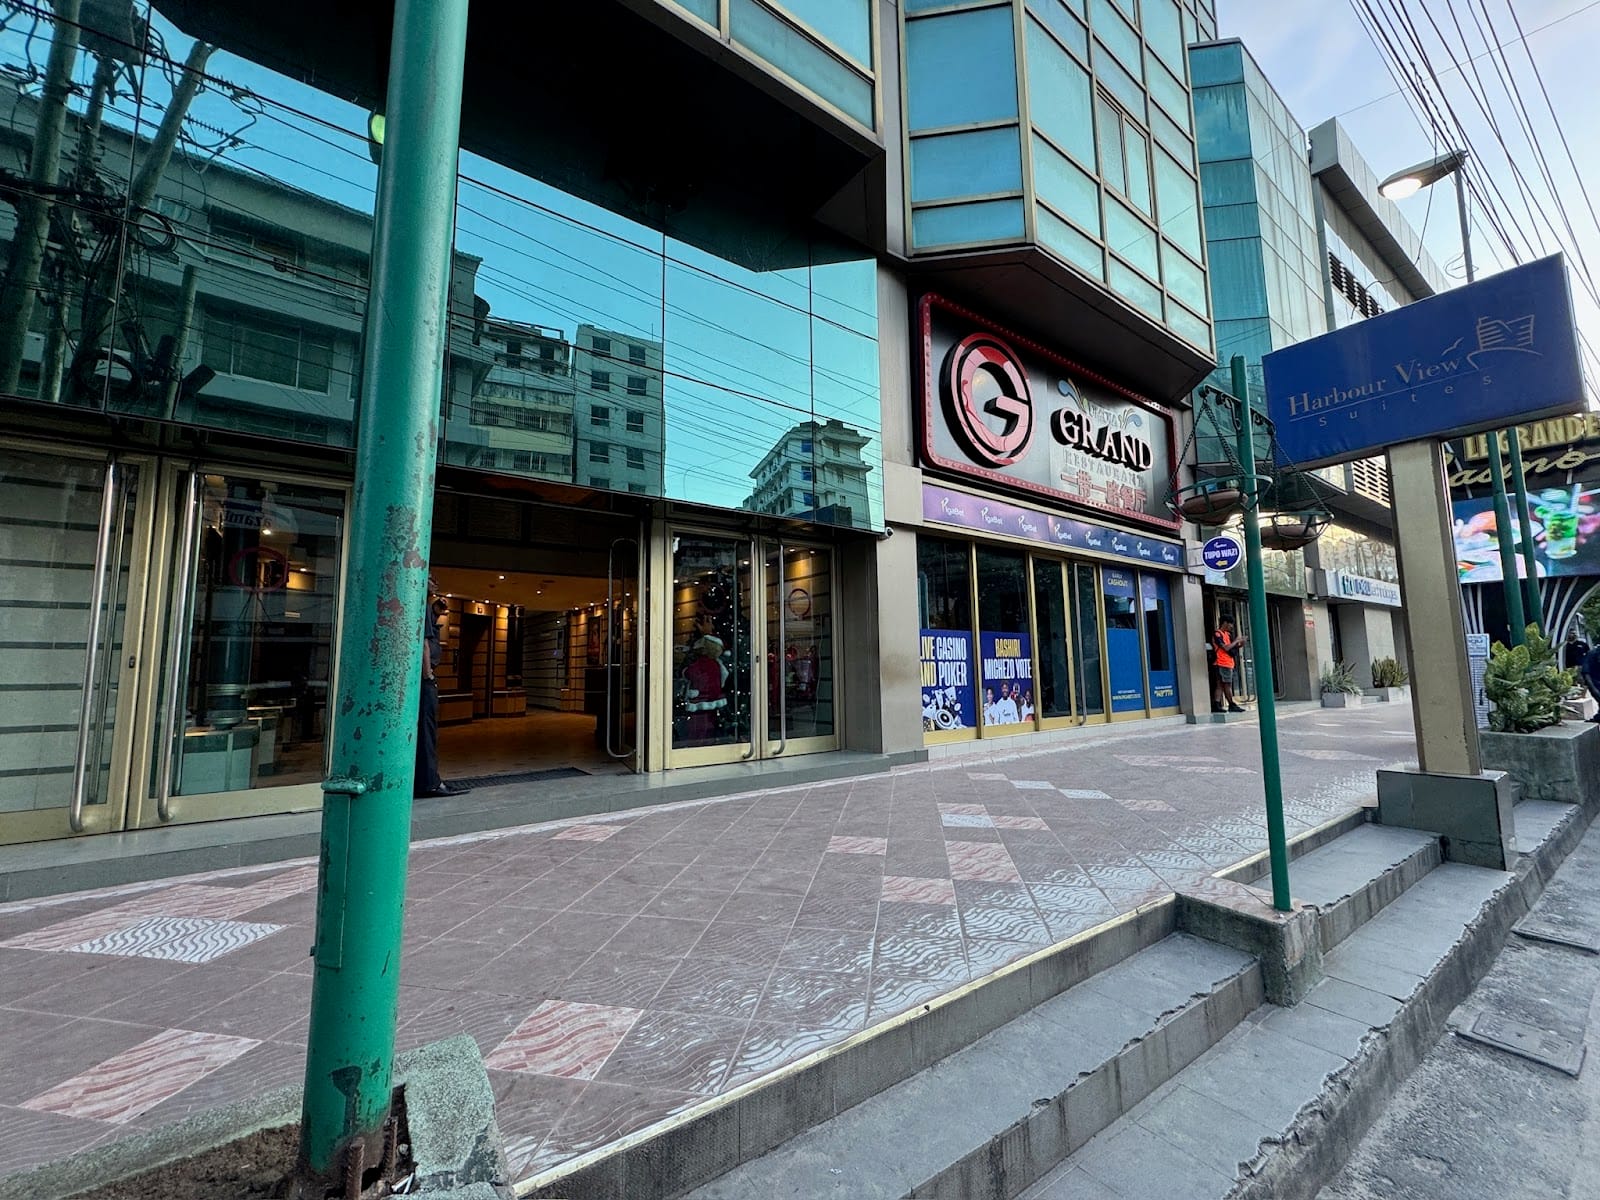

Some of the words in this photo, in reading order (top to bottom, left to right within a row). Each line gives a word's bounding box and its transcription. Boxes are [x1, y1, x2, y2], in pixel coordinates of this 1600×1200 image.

[1288, 379, 1387, 417] Harbour
[1393, 358, 1462, 384] View
[1318, 374, 1493, 427] suites
[1051, 406, 1154, 471] GRAND
[1463, 432, 1489, 460] LE
[1498, 412, 1600, 454] GRANDE
[1064, 448, 1145, 486] RESTAURANT
[1445, 450, 1600, 488] asino
[1204, 550, 1221, 560] TUPO
[1221, 548, 1238, 558] WAZI
[920, 636, 935, 660] IVE
[936, 636, 967, 660] CASINO
[938, 661, 968, 687] POKER
[984, 658, 1015, 680] MICHEZO
[1015, 658, 1032, 679] YOTE
